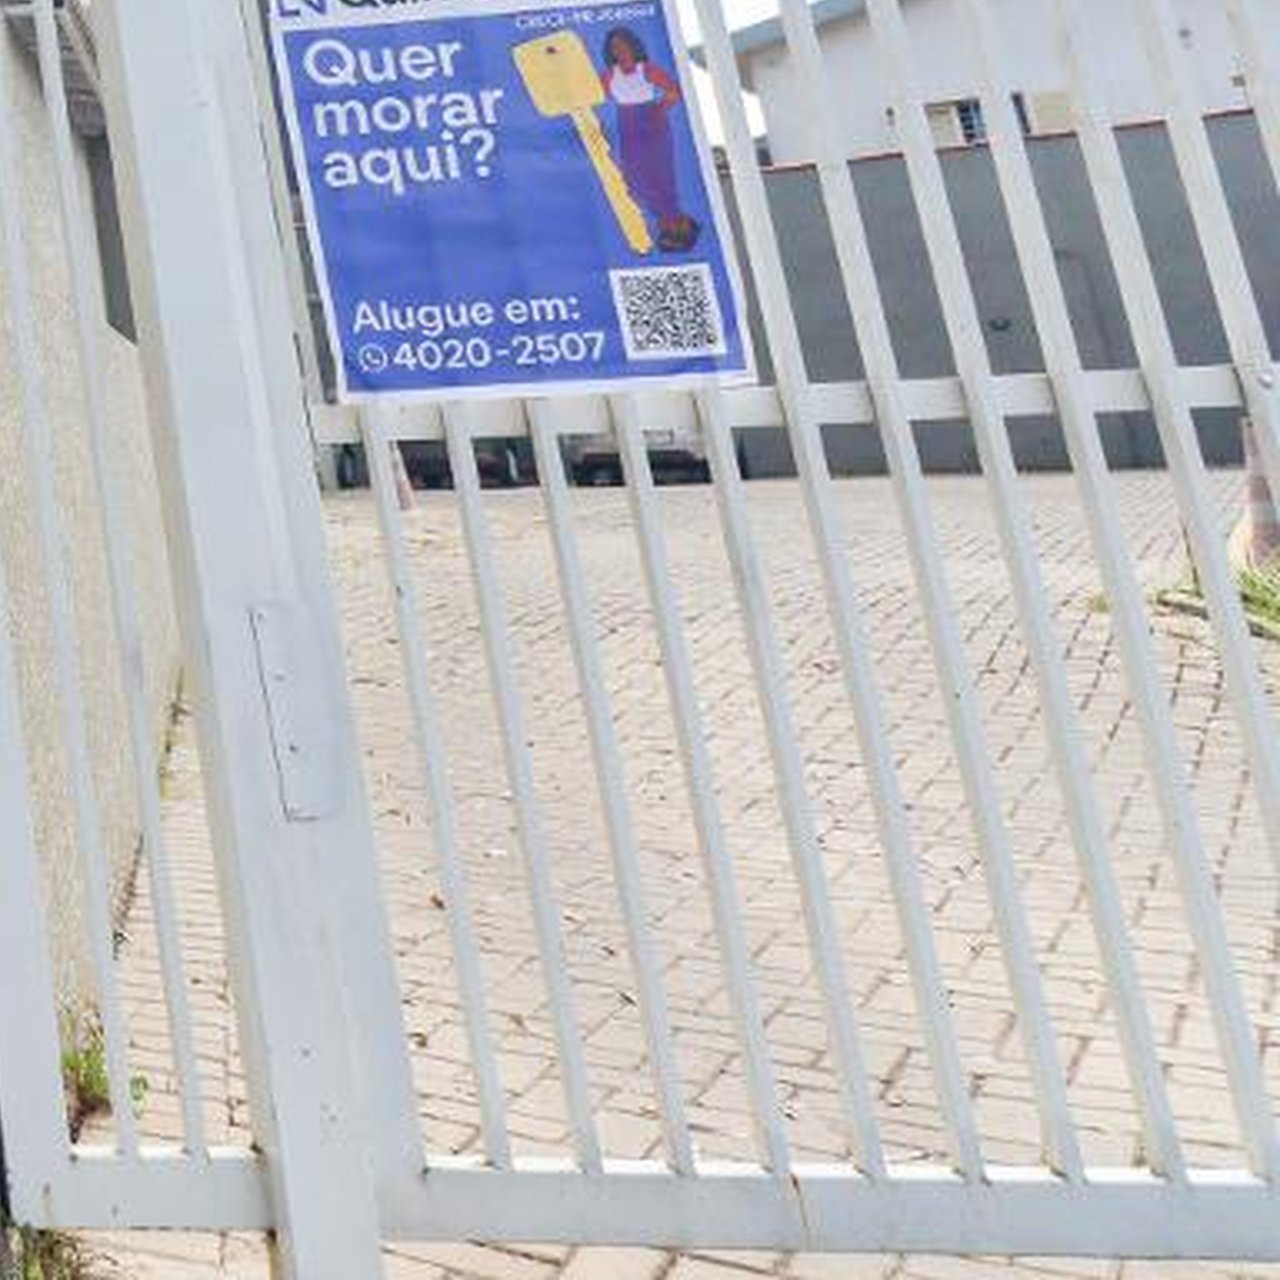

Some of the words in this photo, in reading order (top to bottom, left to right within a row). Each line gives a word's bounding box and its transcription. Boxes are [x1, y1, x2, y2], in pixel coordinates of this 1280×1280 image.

[303, 39, 462, 87] Quer
[313, 91, 503, 137] morar
[324, 131, 495, 195] aqui?
[352, 299, 495, 337] Alugue
[505, 295, 582, 322] em:
[395, 332, 606, 371] 4020-2507
